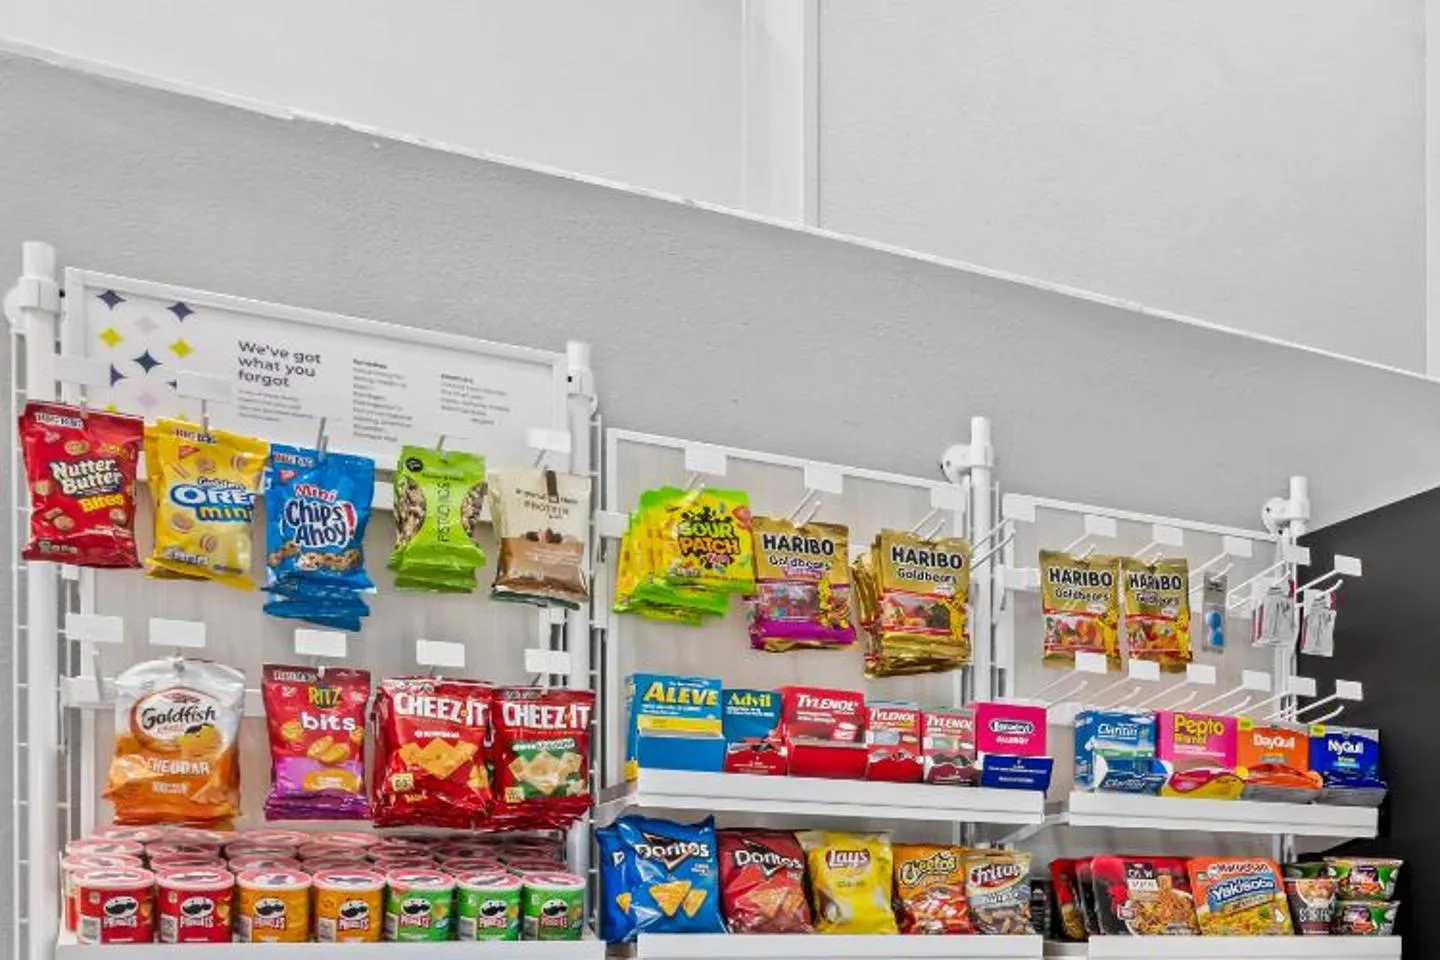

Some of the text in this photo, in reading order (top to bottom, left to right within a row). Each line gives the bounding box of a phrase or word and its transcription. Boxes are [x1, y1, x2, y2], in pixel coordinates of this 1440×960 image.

[238, 340, 321, 365] We've got
[238, 356, 316, 377] what you
[238, 369, 290, 387] forgot
[50, 459, 117, 479] Nutter
[61, 471, 123, 494] Butter
[294, 484, 338, 502] Mini
[78, 494, 125, 513] Bites
[286, 499, 342, 525] Chips
[678, 522, 735, 538] SOUR
[678, 537, 741, 555] PATCH
[763, 534, 834, 556] HARIBO
[892, 546, 962, 569] HARIBO
[898, 568, 957, 584] Goldbears
[1049, 568, 1113, 588] HARIBO
[1129, 573, 1182, 591] HARIBO
[309, 685, 344, 708] RITZ
[643, 681, 719, 706] ALEVE
[728, 693, 772, 708] Advil
[797, 694, 856, 712] TYLENOL
[141, 704, 216, 731] Goldfish
[301, 712, 356, 732] bits
[870, 708, 916, 722] TYLENOL
[927, 715, 973, 729] TYLENOL
[1174, 714, 1224, 736] Pepto
[1253, 734, 1295, 750] DayQuil
[1328, 739, 1364, 754] NyQuil
[635, 842, 710, 858] Doritos
[735, 849, 804, 868] Doritos
